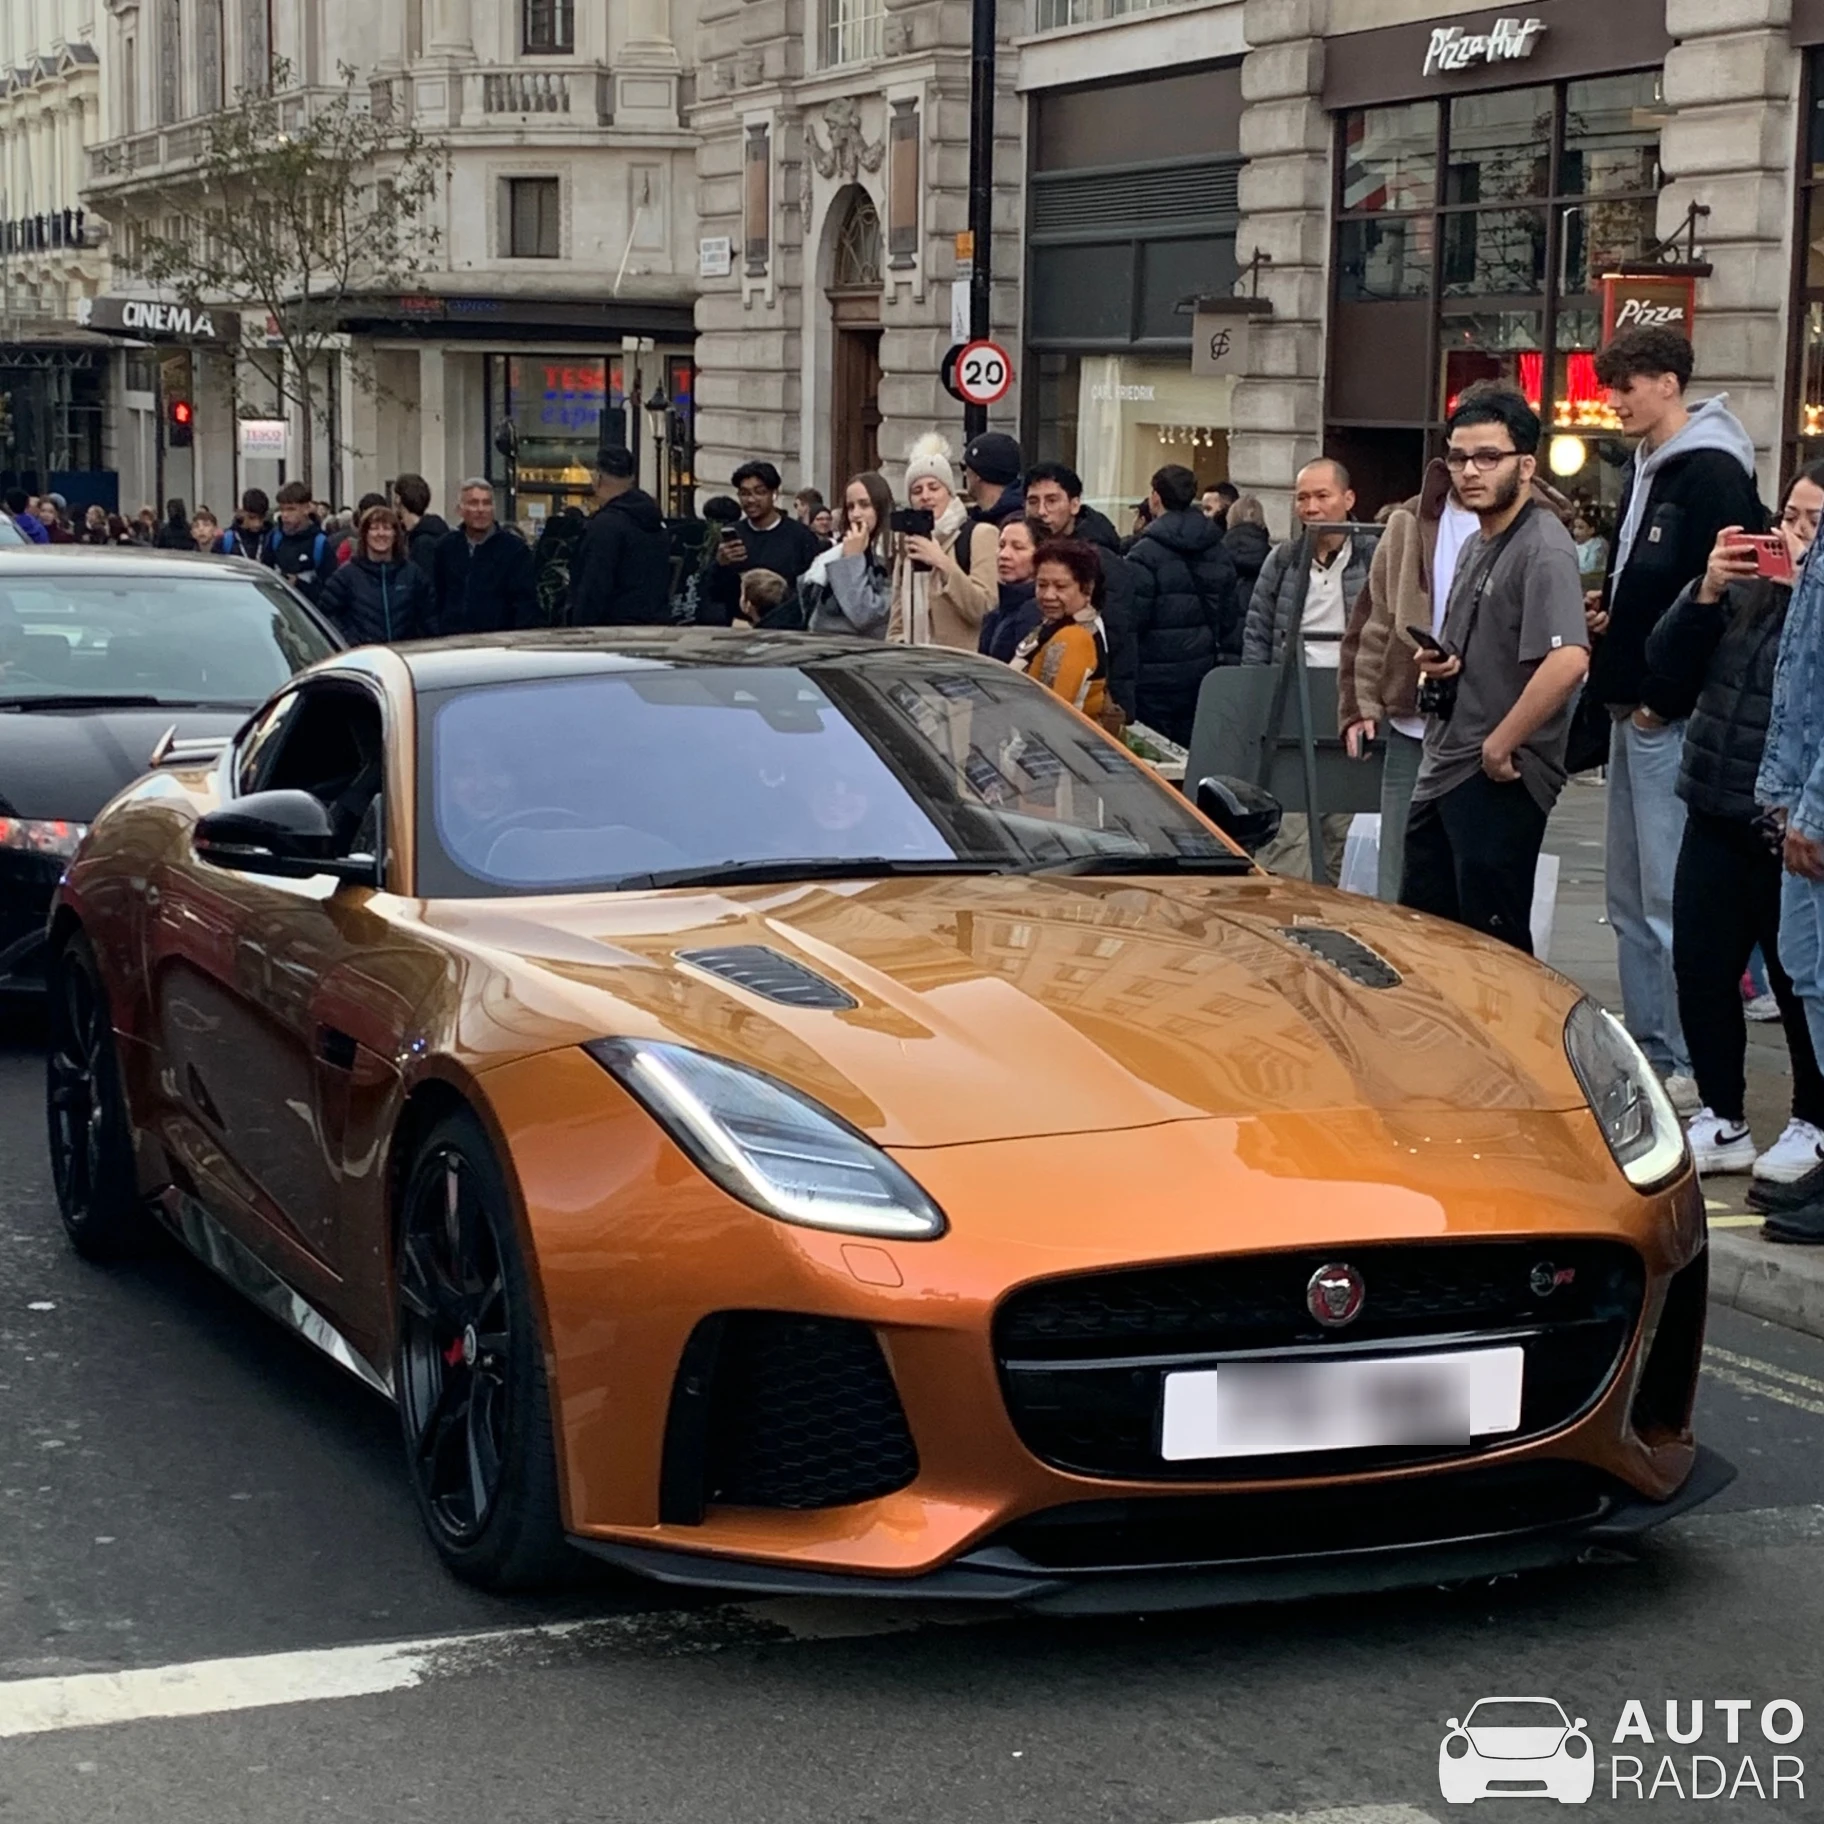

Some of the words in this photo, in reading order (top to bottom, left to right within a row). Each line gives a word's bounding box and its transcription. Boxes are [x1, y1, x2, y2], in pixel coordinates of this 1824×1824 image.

[1423, 26, 1488, 77] Pizza
[1486, 18, 1545, 63] Hut
[122, 301, 216, 337] CINEMA
[1615, 299, 1684, 328] Pizza
[965, 360, 1004, 385] 20
[1091, 384, 1113, 401] CARL
[247, 429, 282, 442] TESCO
